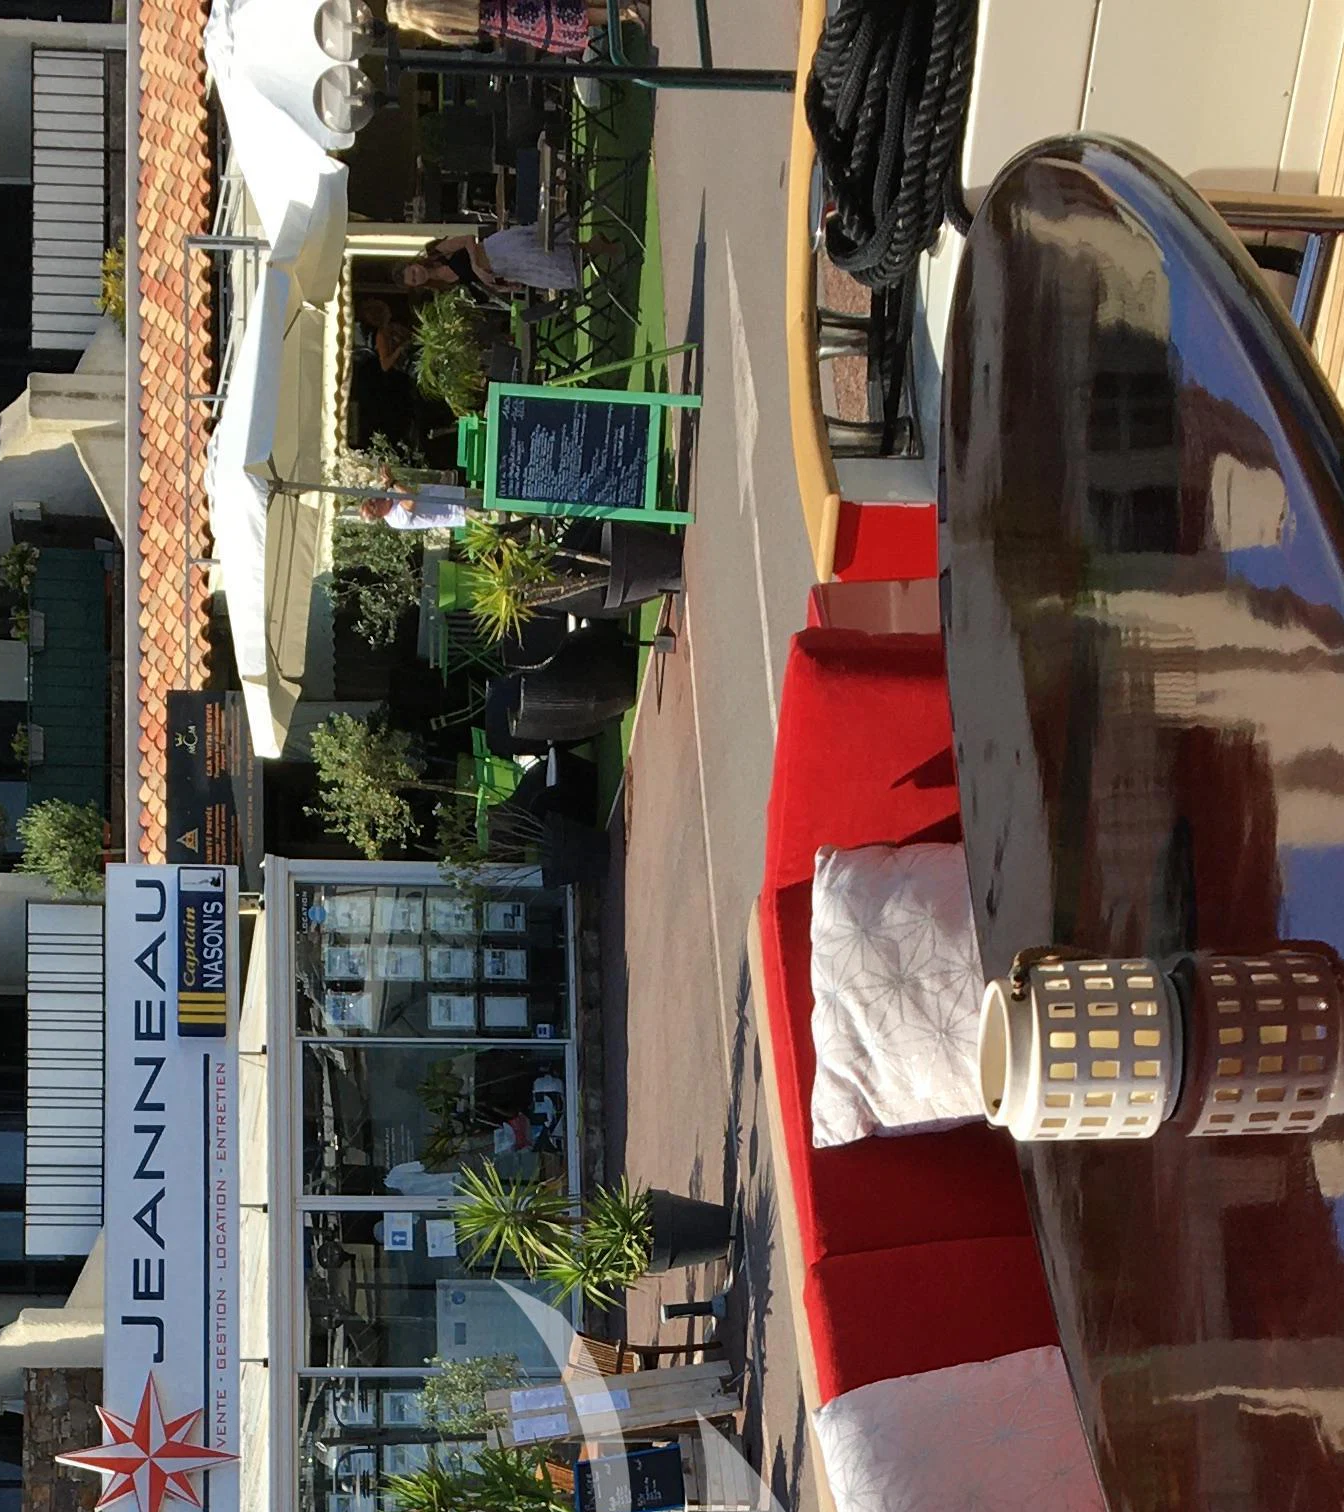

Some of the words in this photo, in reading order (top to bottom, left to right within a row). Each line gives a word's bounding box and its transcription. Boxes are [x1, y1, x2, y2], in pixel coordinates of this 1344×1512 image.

[205, 703, 213, 733] DRIVER
[205, 734, 213, 758] WITH
[182, 906, 198, 987] Captain
[203, 901, 225, 988] NASON'S
[121, 878, 167, 1363] JEANNEAU
[215, 1062, 227, 1161] ENTRETIEN
[216, 1180, 227, 1269] LOCATION
[216, 1289, 227, 1370] GESTION
[216, 1389, 227, 1448] VENTE
